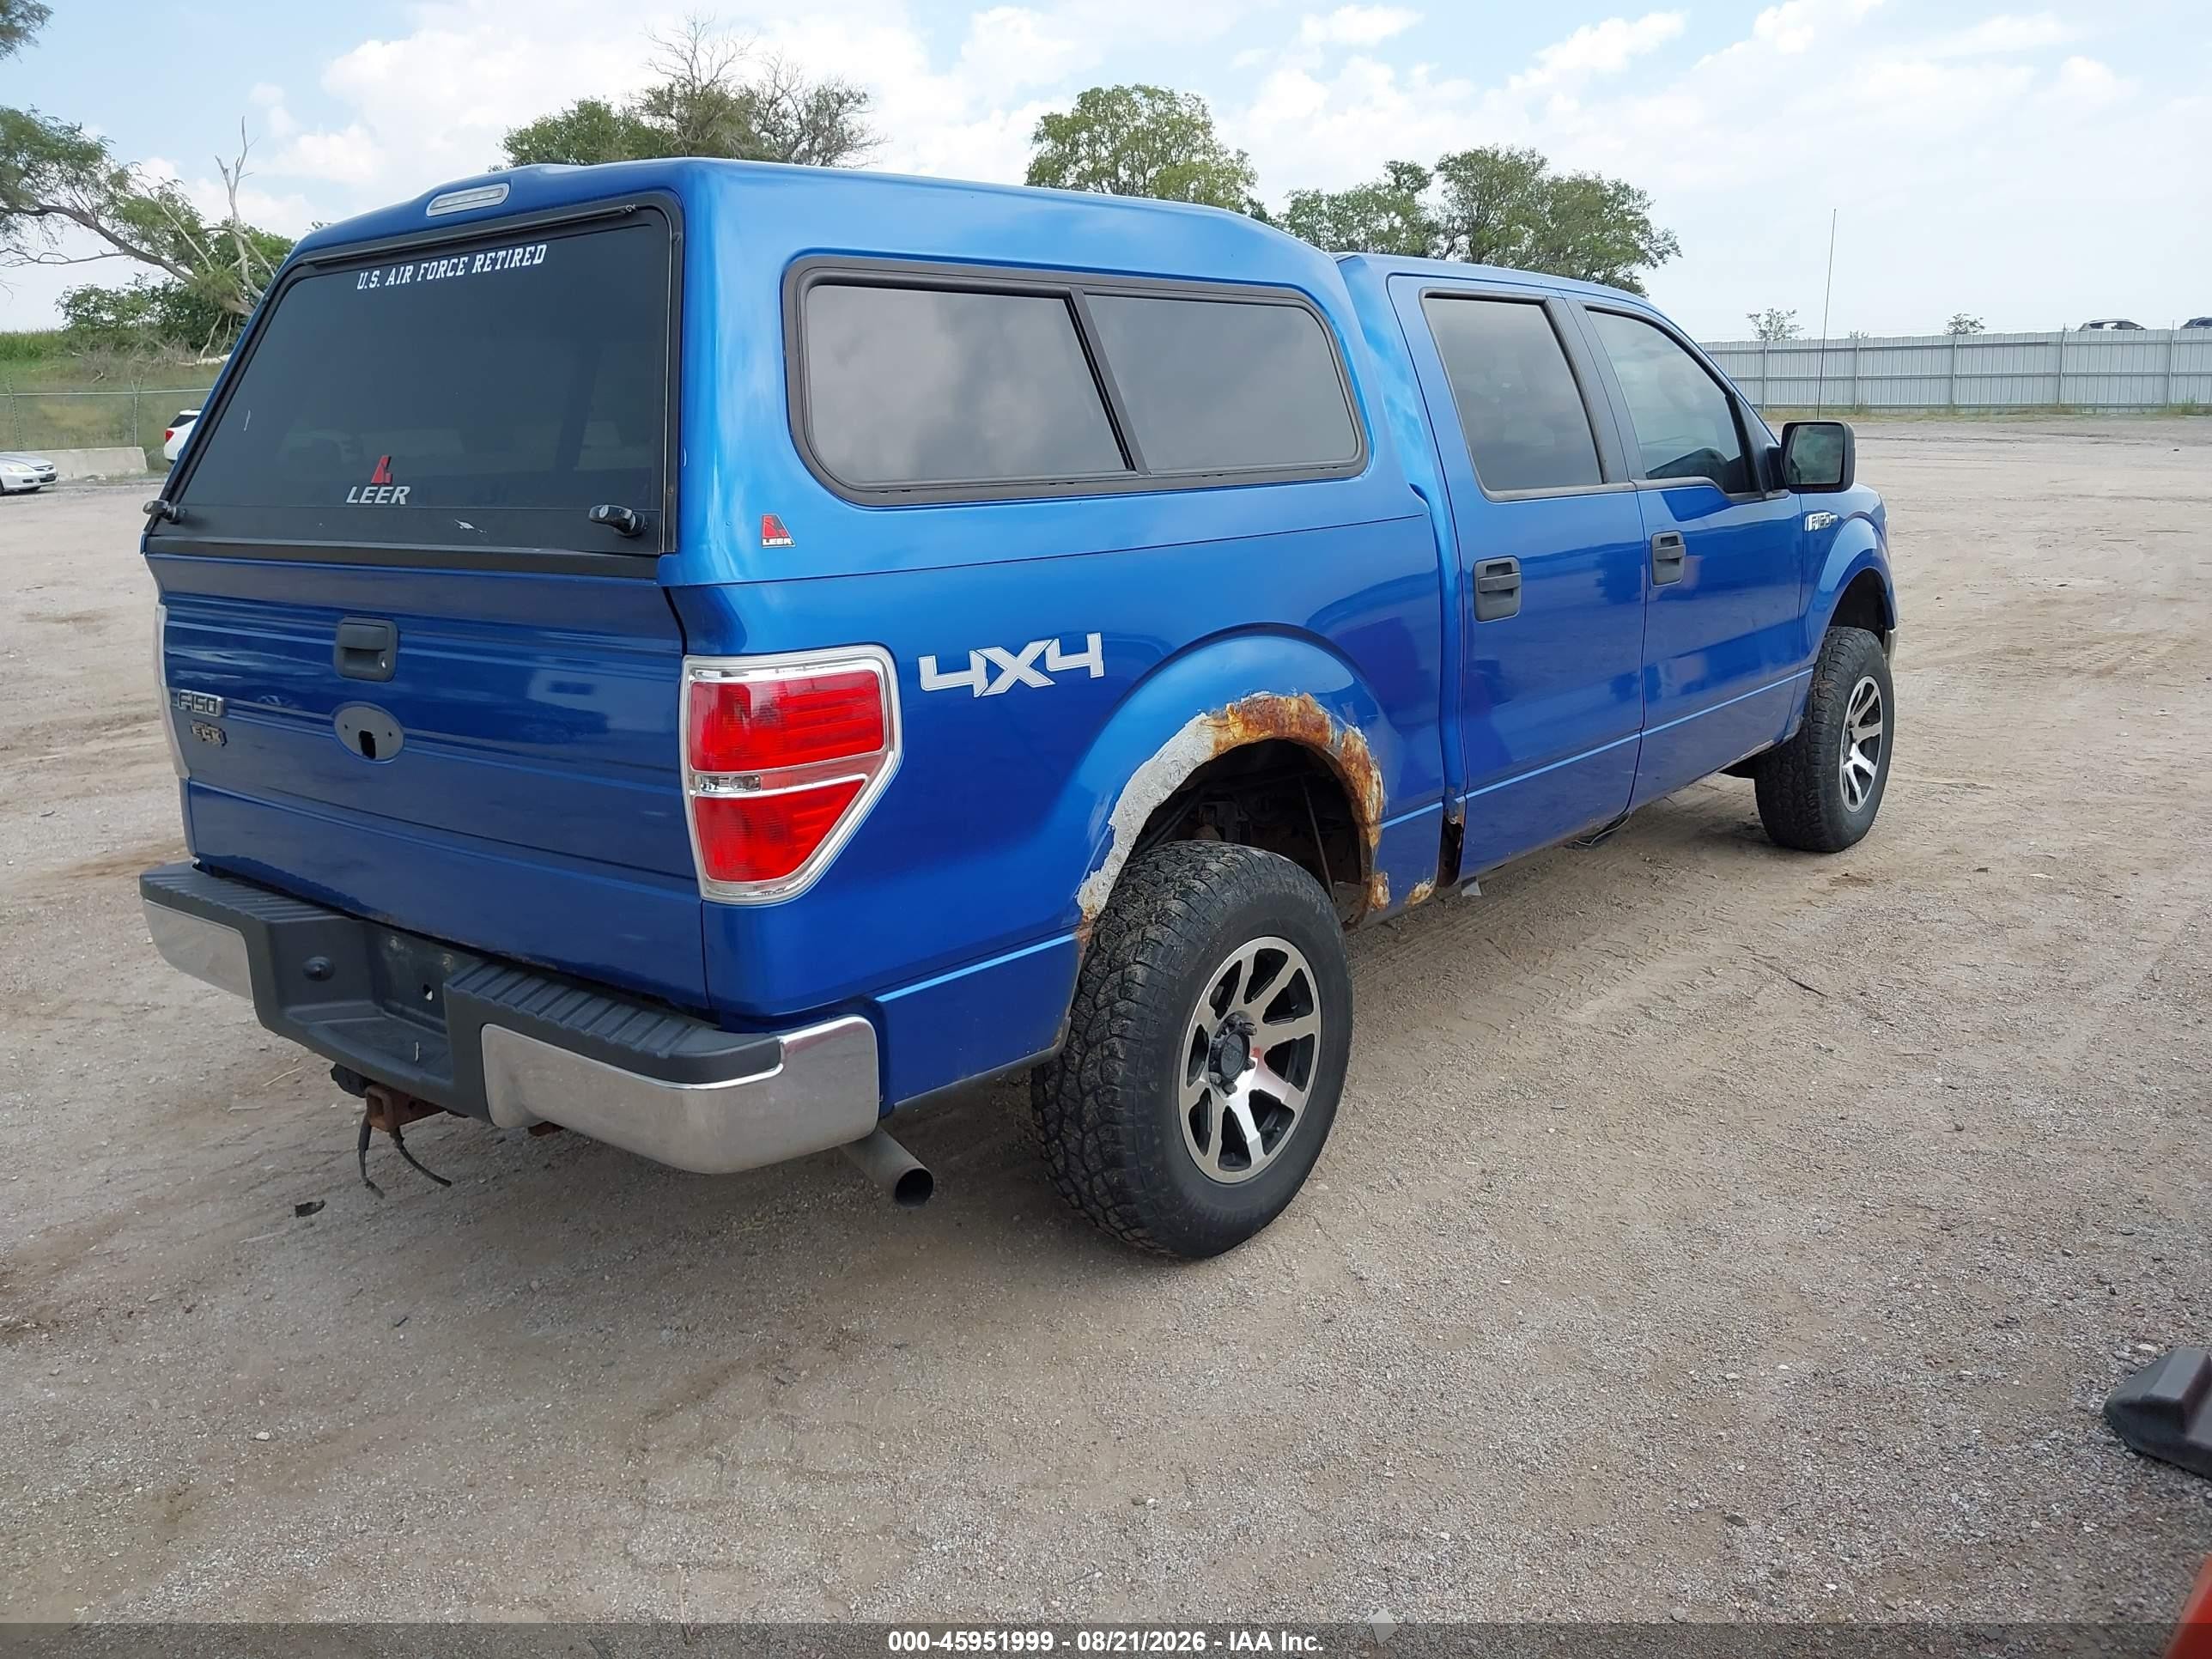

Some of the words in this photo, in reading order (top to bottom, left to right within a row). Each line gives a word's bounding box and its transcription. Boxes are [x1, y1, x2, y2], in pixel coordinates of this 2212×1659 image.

[356, 270, 380, 290] U.S.
[385, 264, 414, 286] AIR
[416, 256, 469, 282] FORCE
[471, 244, 548, 273] RETIRED
[345, 486, 410, 505] LEER
[762, 538, 793, 546] LEER
[918, 632, 1105, 698] 4X4
